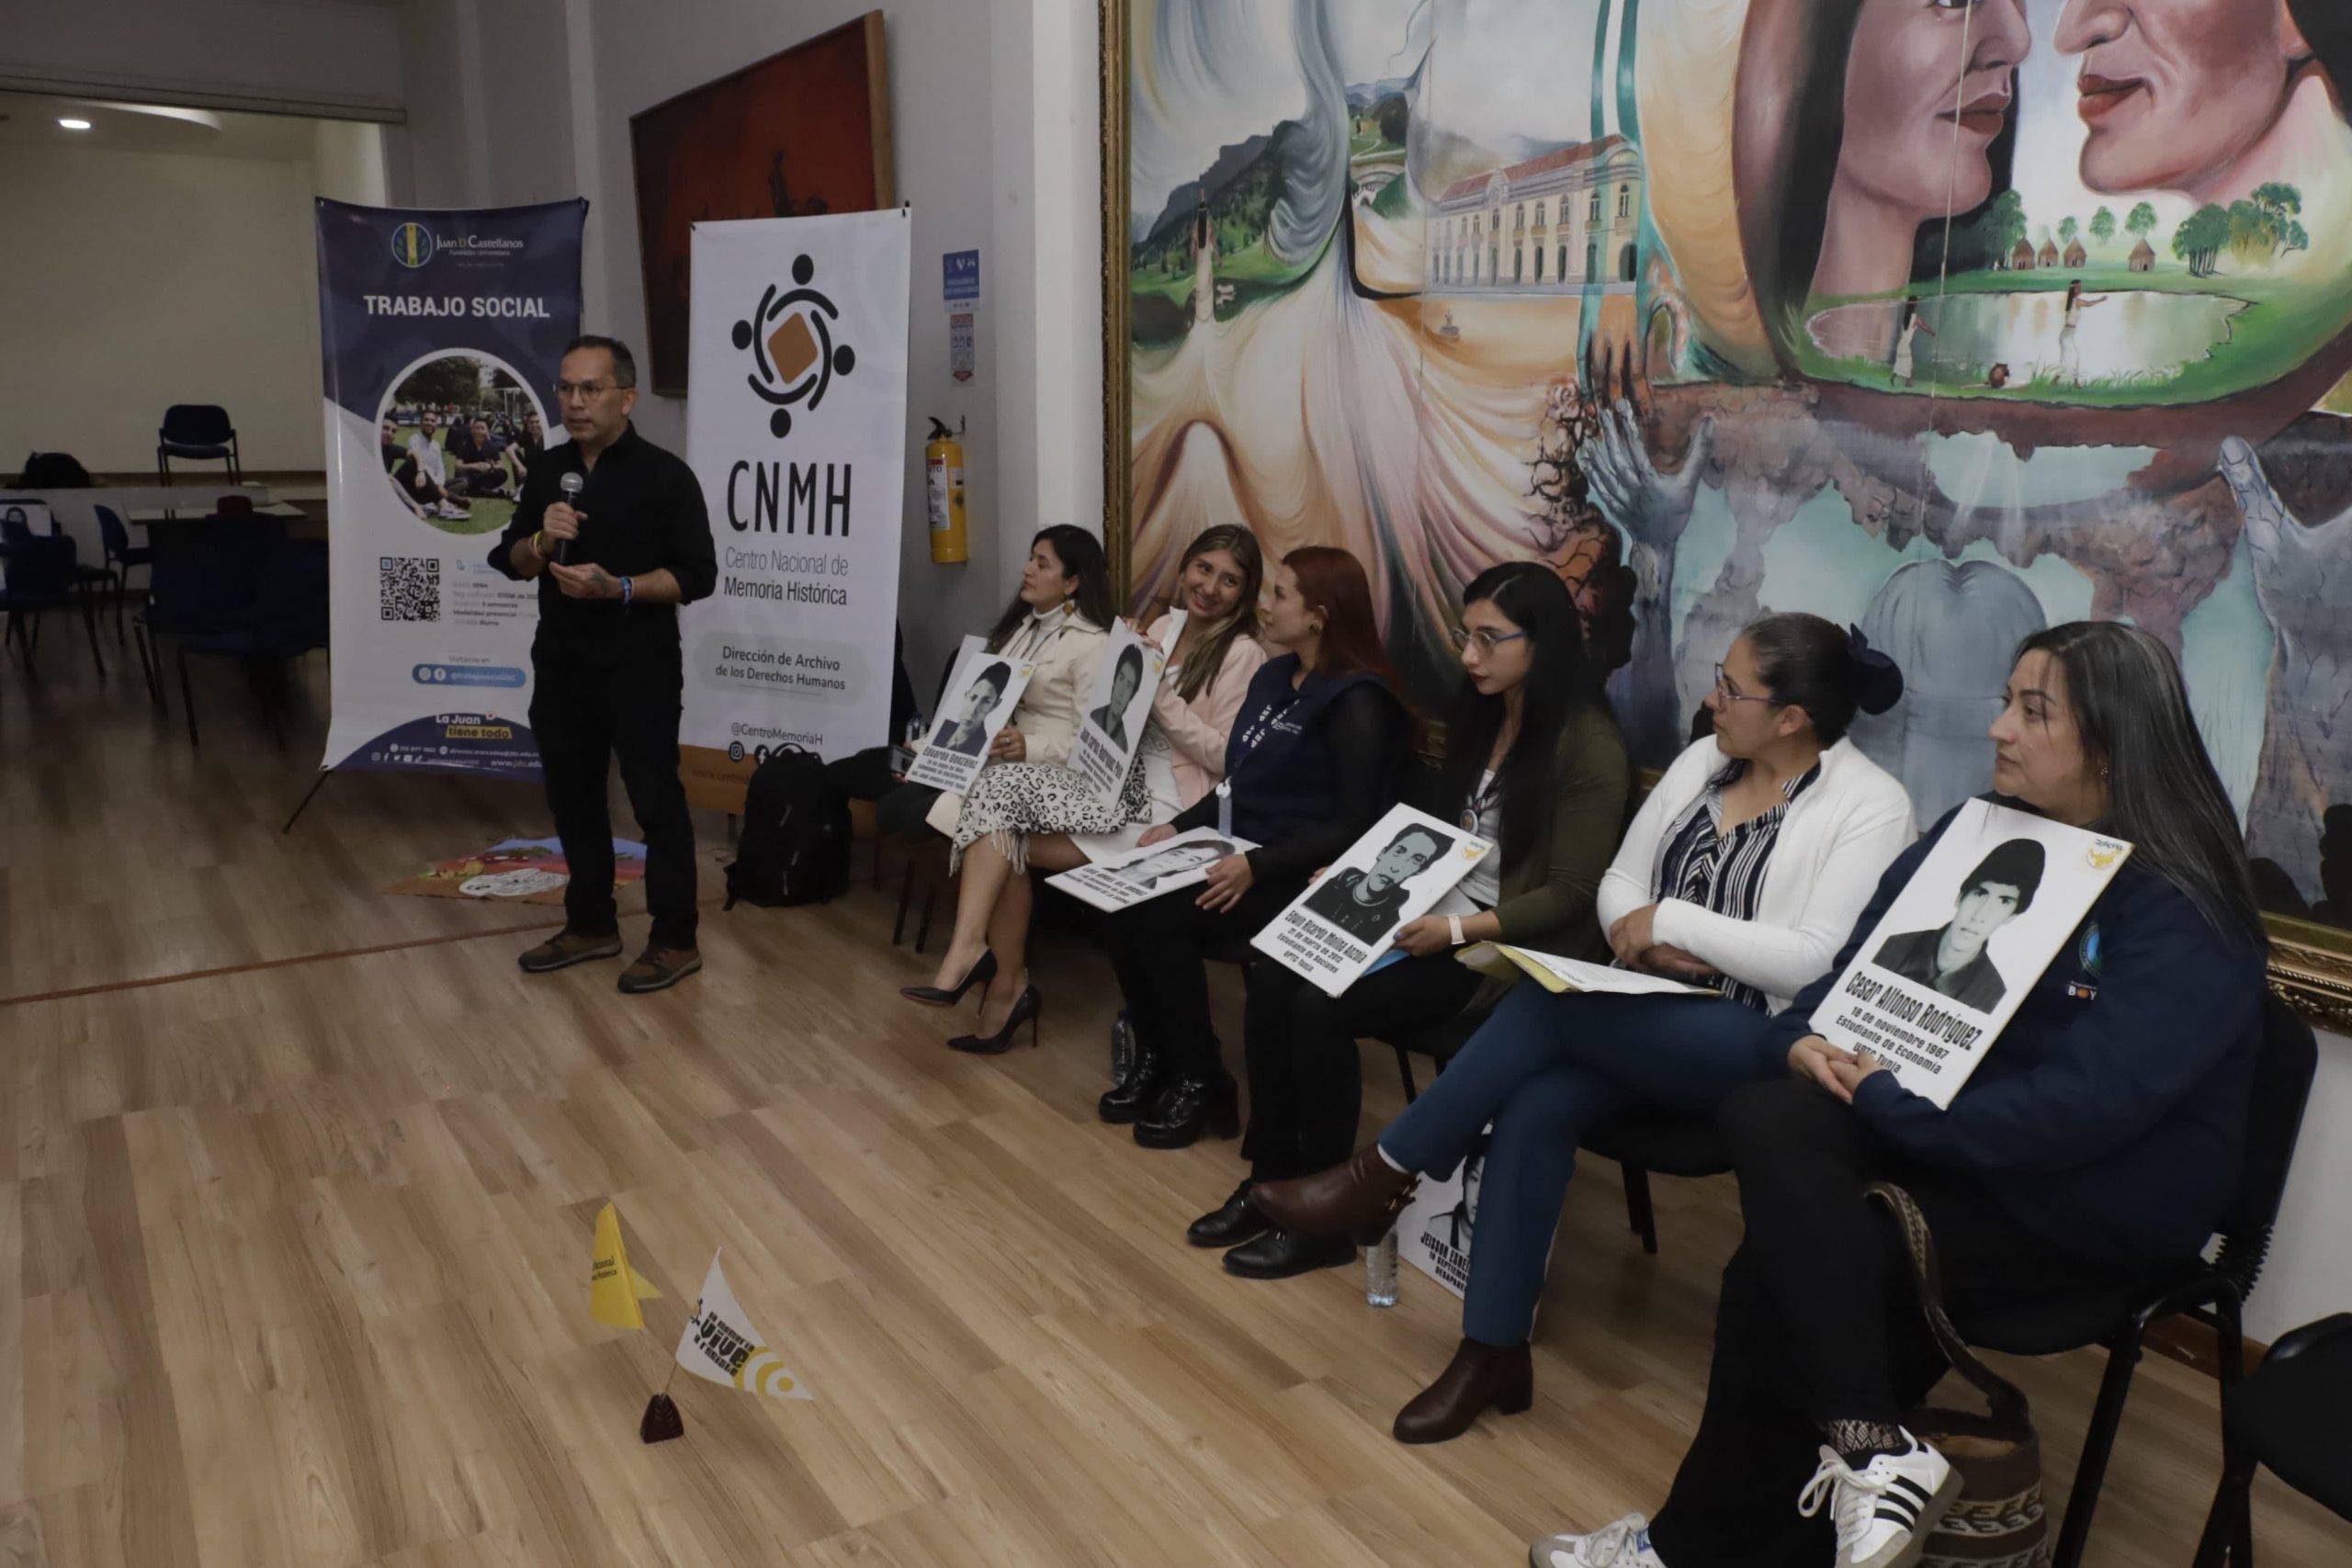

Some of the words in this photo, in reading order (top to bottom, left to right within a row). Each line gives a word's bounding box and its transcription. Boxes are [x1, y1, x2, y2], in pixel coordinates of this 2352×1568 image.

[436, 234, 457, 250] Juan
[469, 234, 524, 248] Castellanos
[363, 295, 466, 317] TRABAJO
[470, 297, 550, 318] SOCIAL
[727, 459, 852, 537] CNMH
[725, 547, 767, 570] Centro
[772, 549, 827, 574] Nacional
[831, 554, 849, 576] de
[724, 576, 783, 600] Memoria
[786, 581, 847, 605] Histórica
[722, 646, 775, 664] Dirección
[777, 652, 792, 666] de
[795, 654, 840, 671] Archivo
[715, 664, 728, 677] de
[730, 666, 745, 678] los
[747, 667, 794, 683] Derechos
[797, 673, 845, 690] Humanos
[435, 714, 450, 724] La
[451, 715, 481, 725] Juan
[448, 726, 479, 738] tiene
[481, 727, 509, 739] todo
[731, 722, 823, 745] @CentroMemoriaH
[1277, 932, 1306, 953] Estudiante
[1305, 950, 1314, 958] de
[1845, 971, 1883, 1003] Cesar
[1875, 985, 1923, 1022] Alfonso
[1916, 1003, 1983, 1051] Rodríguez
[1836, 1014, 1883, 1043] Estudiante
[1882, 1037, 1894, 1051] de
[1850, 1006, 1863, 1017] 18
[1861, 1010, 1875, 1024] de
[1874, 1018, 1926, 1049] noviembre
[1925, 1043, 1950, 1060] 1987
[1877, 1055, 1902, 1074] Tunja
[1420, 1232, 1449, 1259] JEISSON
[1437, 1256, 1470, 1281] SEPTIEMB
[700, 1317, 750, 1369] vive
[718, 1320, 755, 1353] memoria
